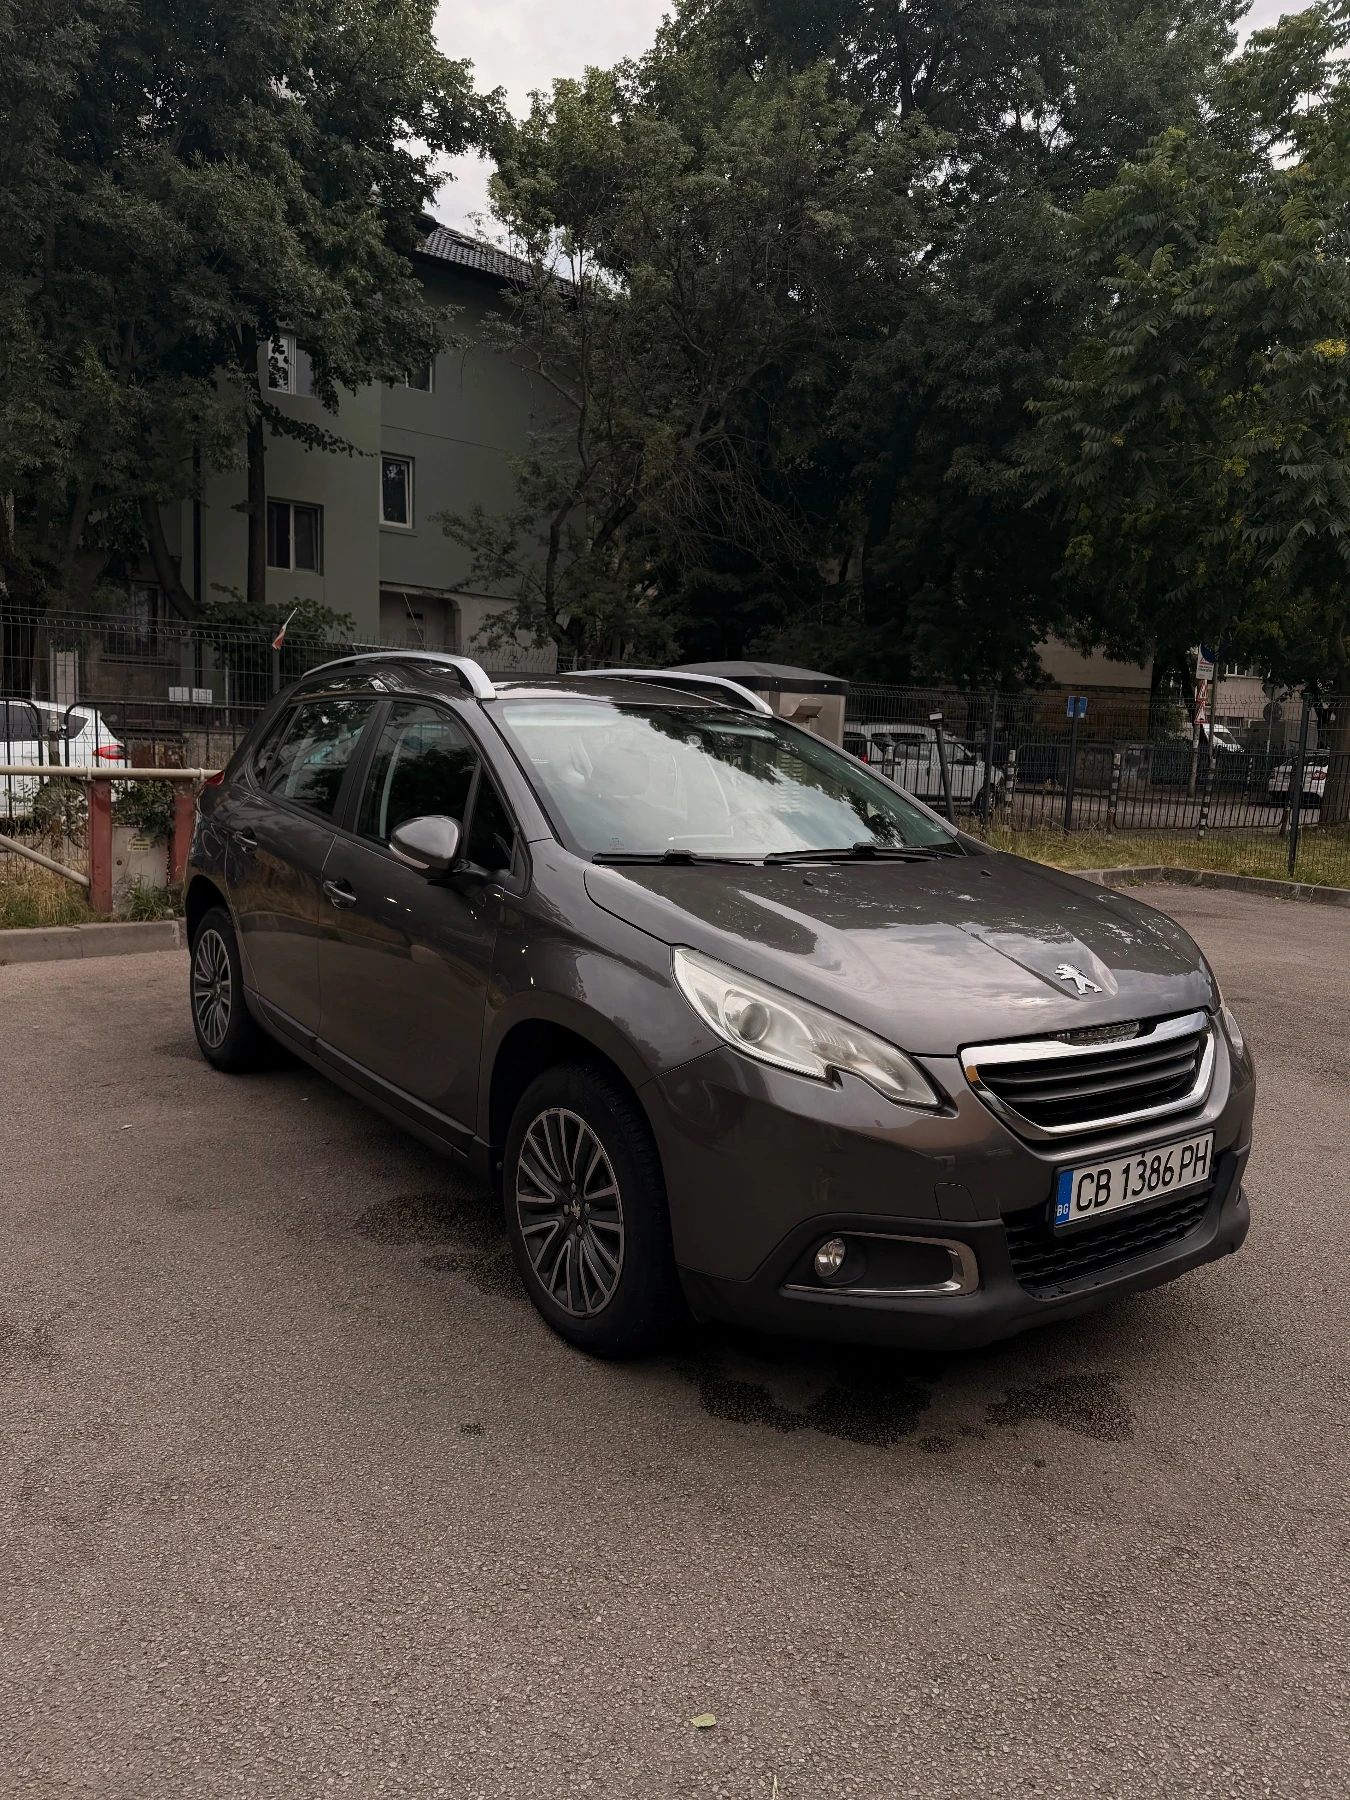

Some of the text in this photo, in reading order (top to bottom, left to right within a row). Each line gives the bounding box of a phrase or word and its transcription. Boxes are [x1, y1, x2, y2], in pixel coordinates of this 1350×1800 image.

[1076, 1138, 1210, 1212] CB 1386 PH
[1056, 1203, 1069, 1216] BG
